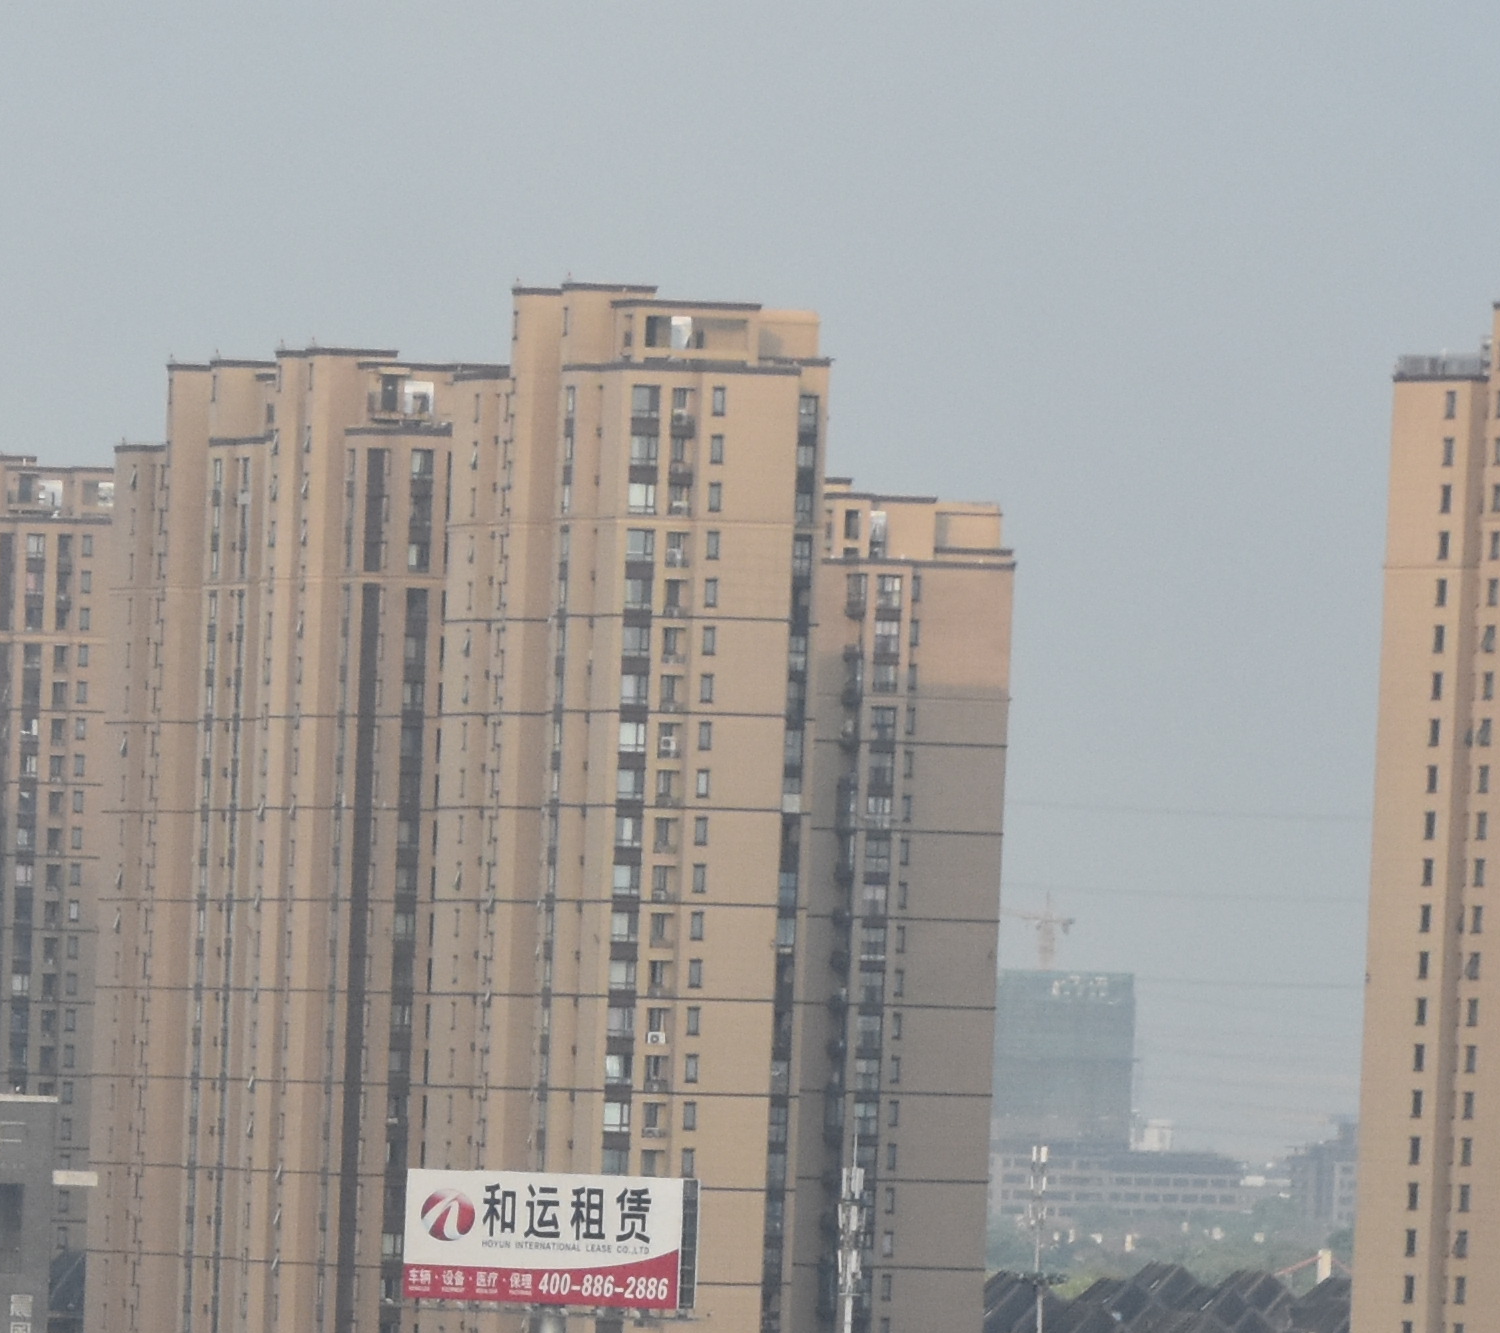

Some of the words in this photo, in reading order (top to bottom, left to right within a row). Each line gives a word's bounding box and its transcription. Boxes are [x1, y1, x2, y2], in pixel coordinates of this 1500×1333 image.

[482, 1183, 651, 1244] 和运租赁
[482, 1240, 510, 1248] HOYUN
[515, 1241, 580, 1251] INTERNATIONAL
[586, 1244, 611, 1253] LEASE
[538, 1272, 669, 1300] 400-886-2886
